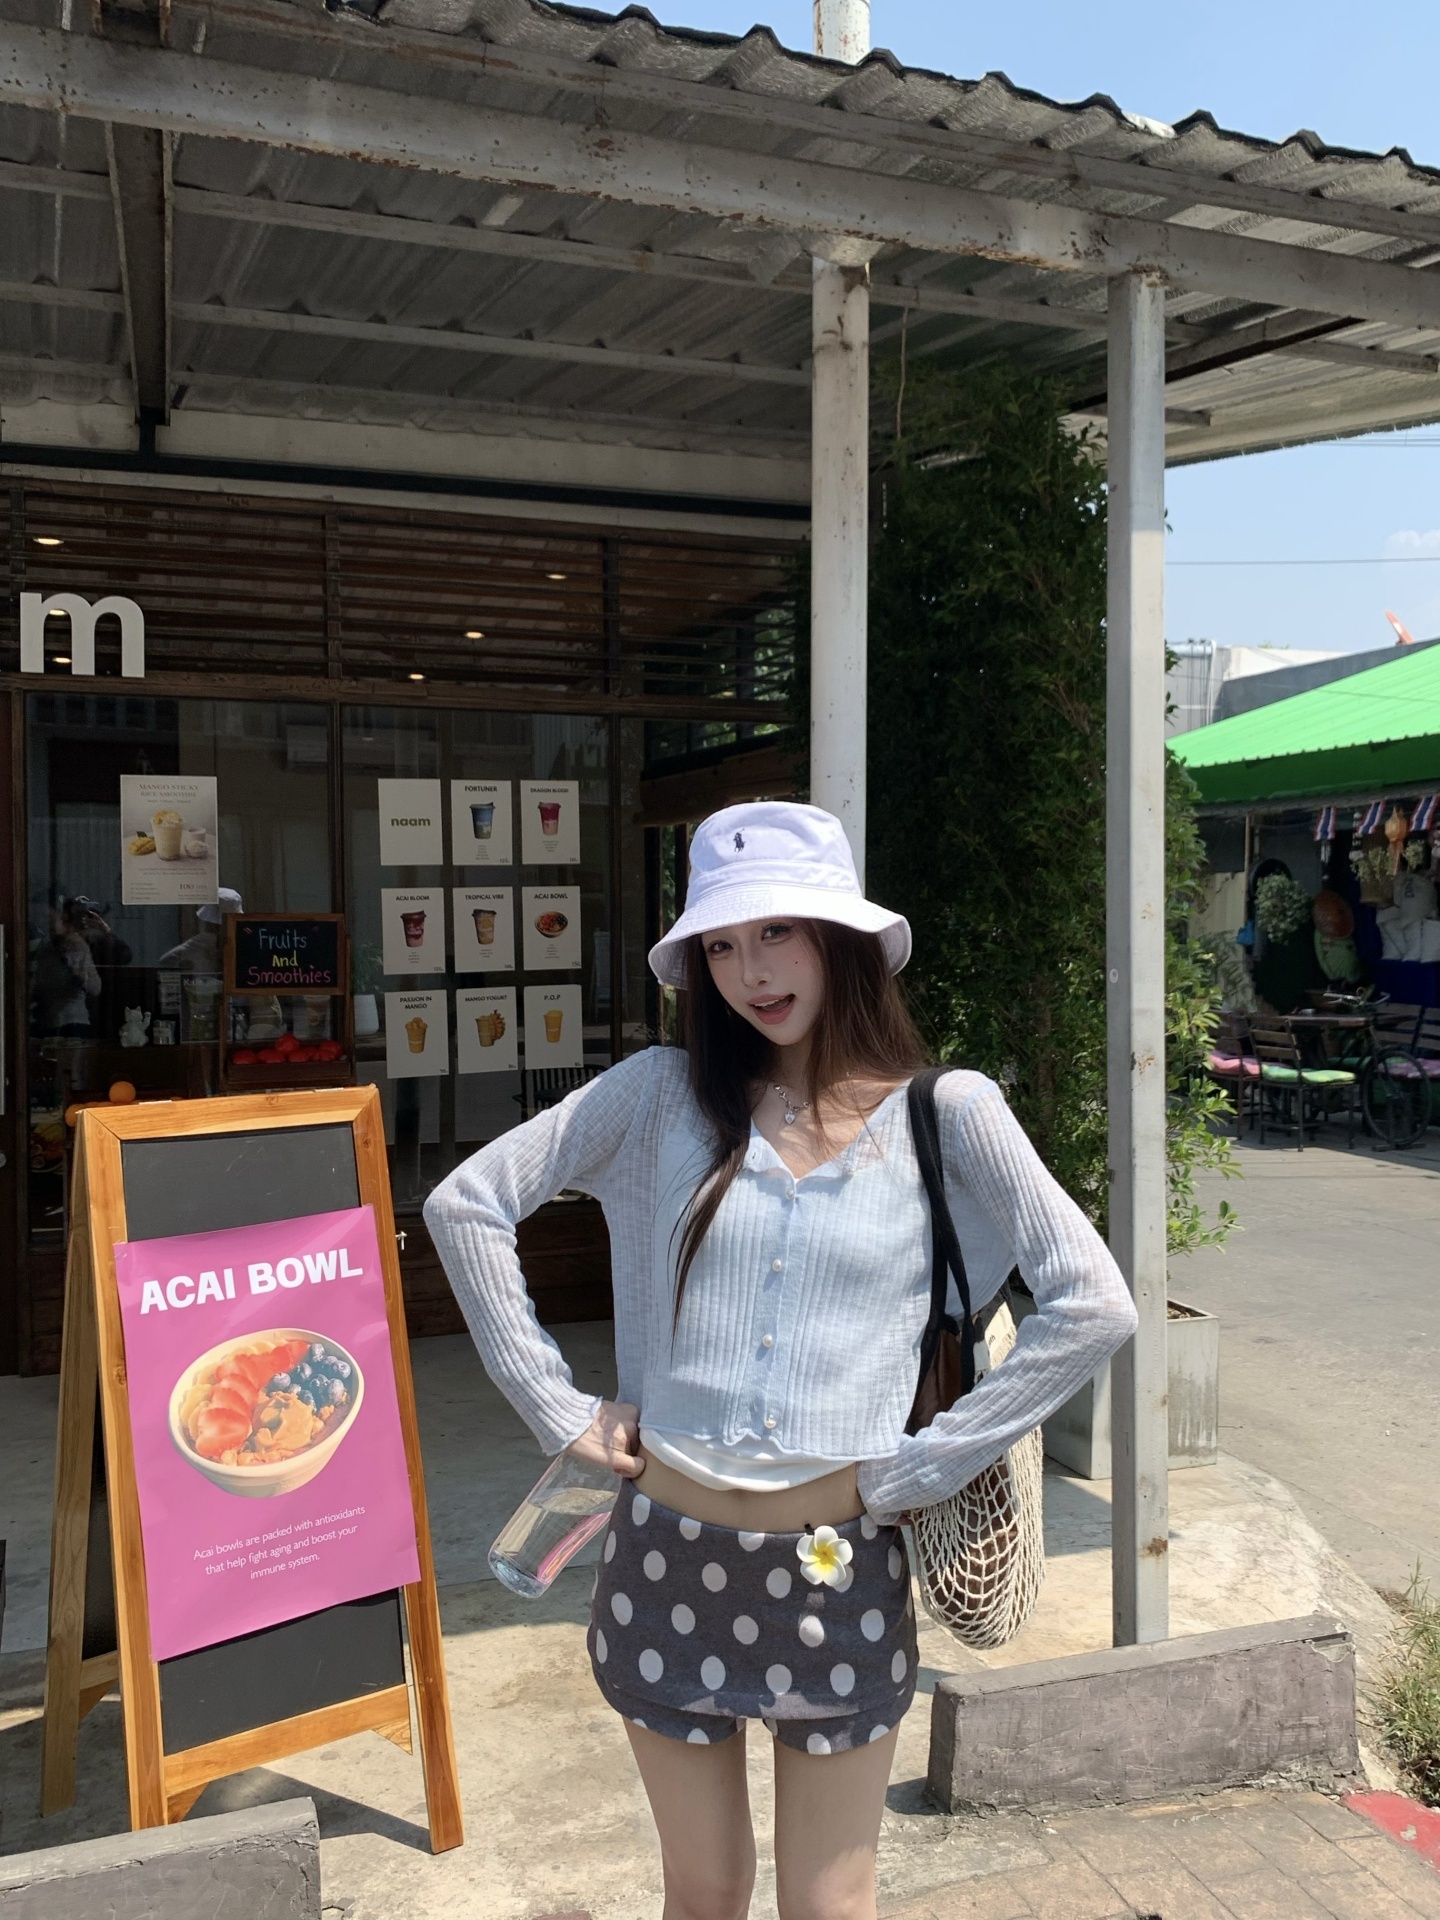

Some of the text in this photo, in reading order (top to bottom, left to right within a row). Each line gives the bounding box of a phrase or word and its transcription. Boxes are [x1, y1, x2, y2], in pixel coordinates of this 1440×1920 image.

[20, 592, 145, 678] m
[391, 817, 431, 827] naam
[258, 928, 307, 949] Fruits
[272, 950, 299, 967] And
[247, 964, 331, 986] Smoothies
[140, 1248, 363, 1315] ACAI BOWL
[193, 1506, 366, 1560] Acai bowls are packed with antioxidants
[205, 1525, 358, 1575] that help fight aging and boost your
[250, 1552, 320, 1580] immune system.
